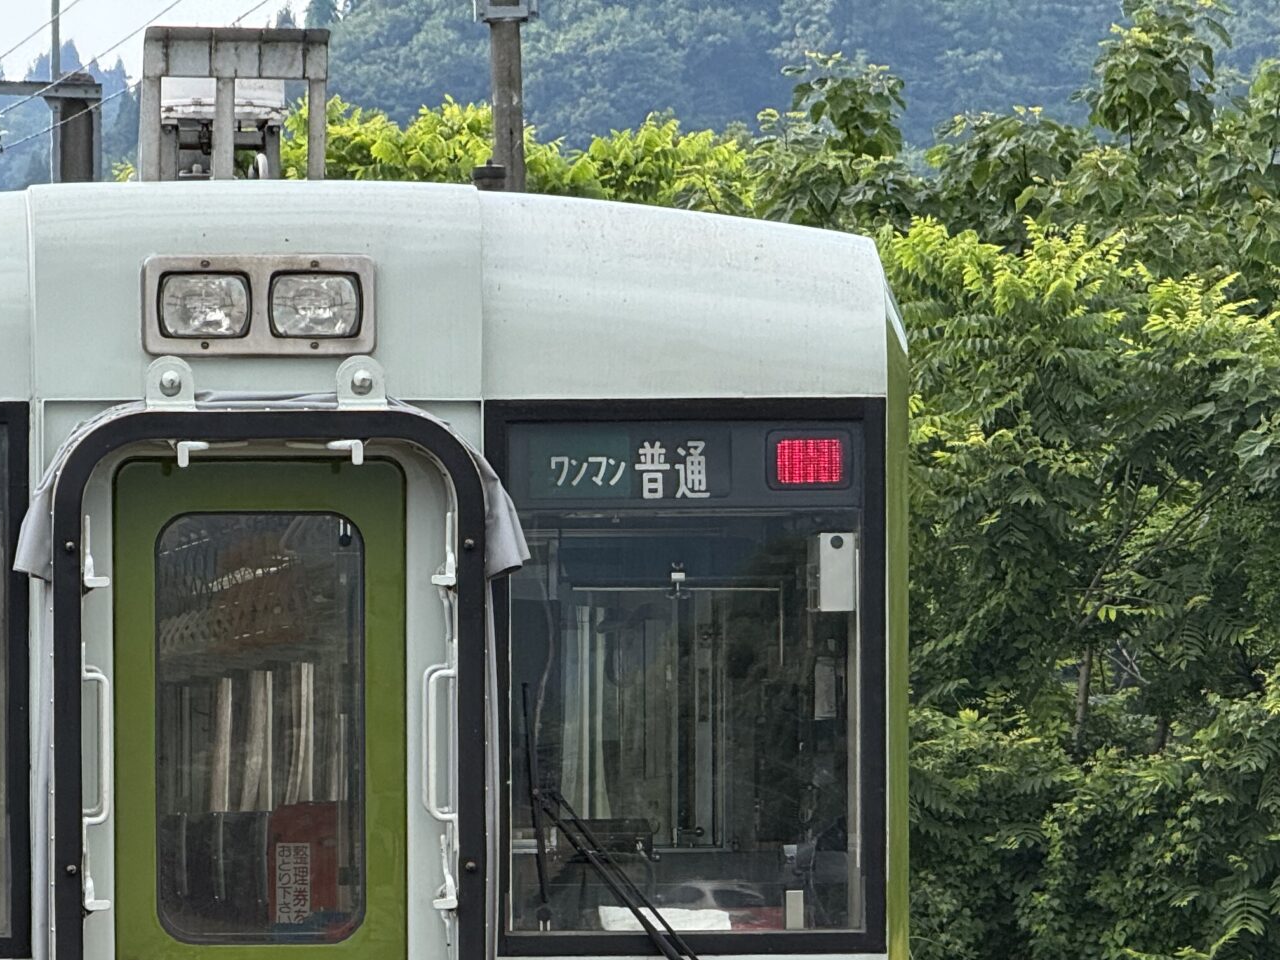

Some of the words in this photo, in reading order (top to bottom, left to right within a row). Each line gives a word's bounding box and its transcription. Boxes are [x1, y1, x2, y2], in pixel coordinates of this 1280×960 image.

[550, 456, 626, 486] ワンマン
[634, 440, 711, 499] 普通
[278, 846, 293, 923] おとり下さい
[293, 846, 309, 922] 整理券を
